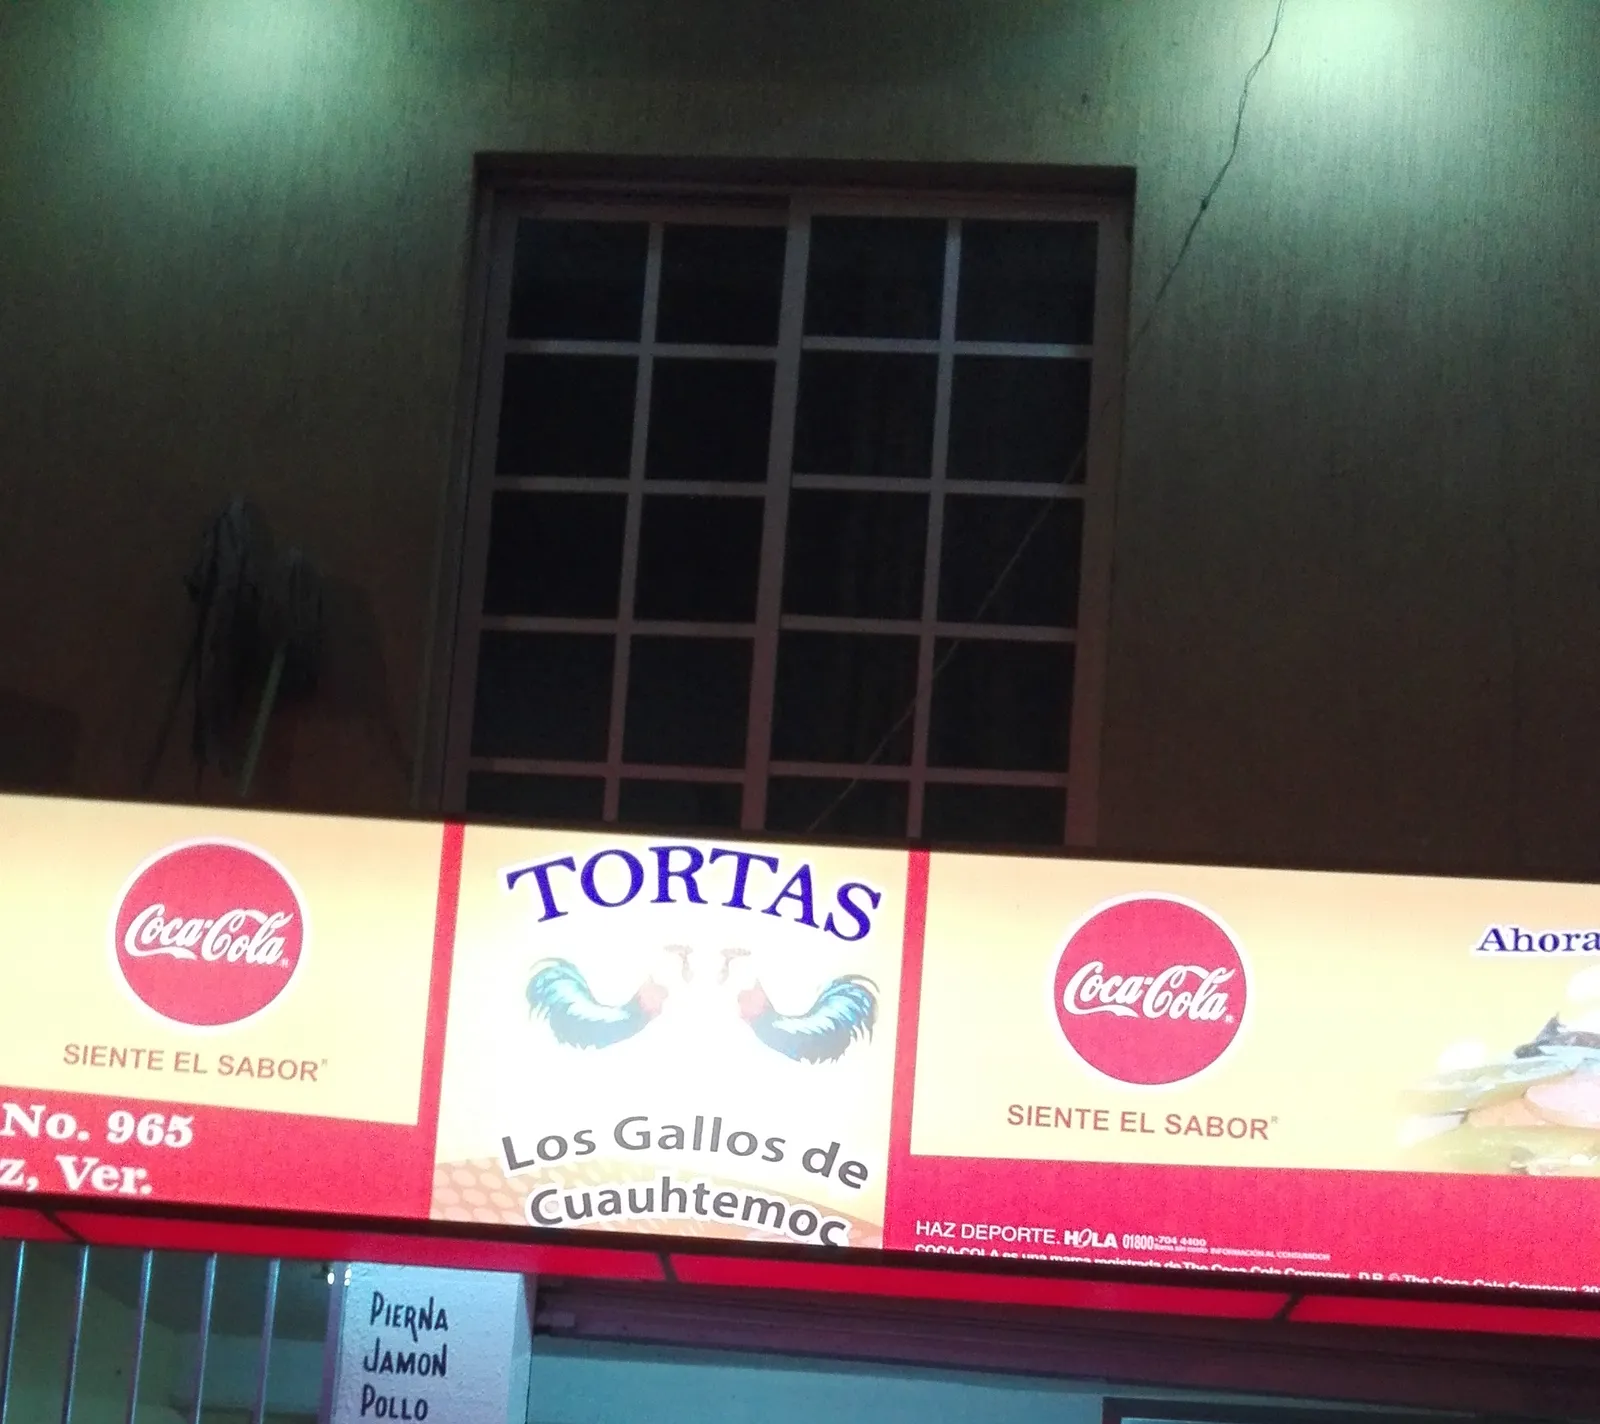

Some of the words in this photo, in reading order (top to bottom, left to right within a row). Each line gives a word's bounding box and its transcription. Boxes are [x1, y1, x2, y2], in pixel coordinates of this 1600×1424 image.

[506, 845, 882, 941] TORTAS
[1476, 927, 1600, 953] Ahora
[63, 1043, 164, 1072] SIENTE
[173, 1051, 208, 1076] EL
[0, 1102, 91, 1142] No.
[106, 1110, 196, 1148] 965
[1007, 1103, 1110, 1133] SIENTE
[1120, 1111, 1156, 1135] EL
[502, 1129, 597, 1172] Los
[613, 1115, 786, 1163] Gallos
[801, 1141, 868, 1190] de
[55, 1153, 154, 1196] Ver.
[531, 1176, 847, 1247] Cuauhtemoc
[915, 1219, 956, 1238] HAZ
[960, 1222, 1061, 1245] DEPORTE.
[1063, 1228, 1119, 1249] HOLA
[370, 1291, 449, 1342] PIERNA
[363, 1337, 448, 1377] JAMON
[360, 1383, 429, 1421] POLLO
